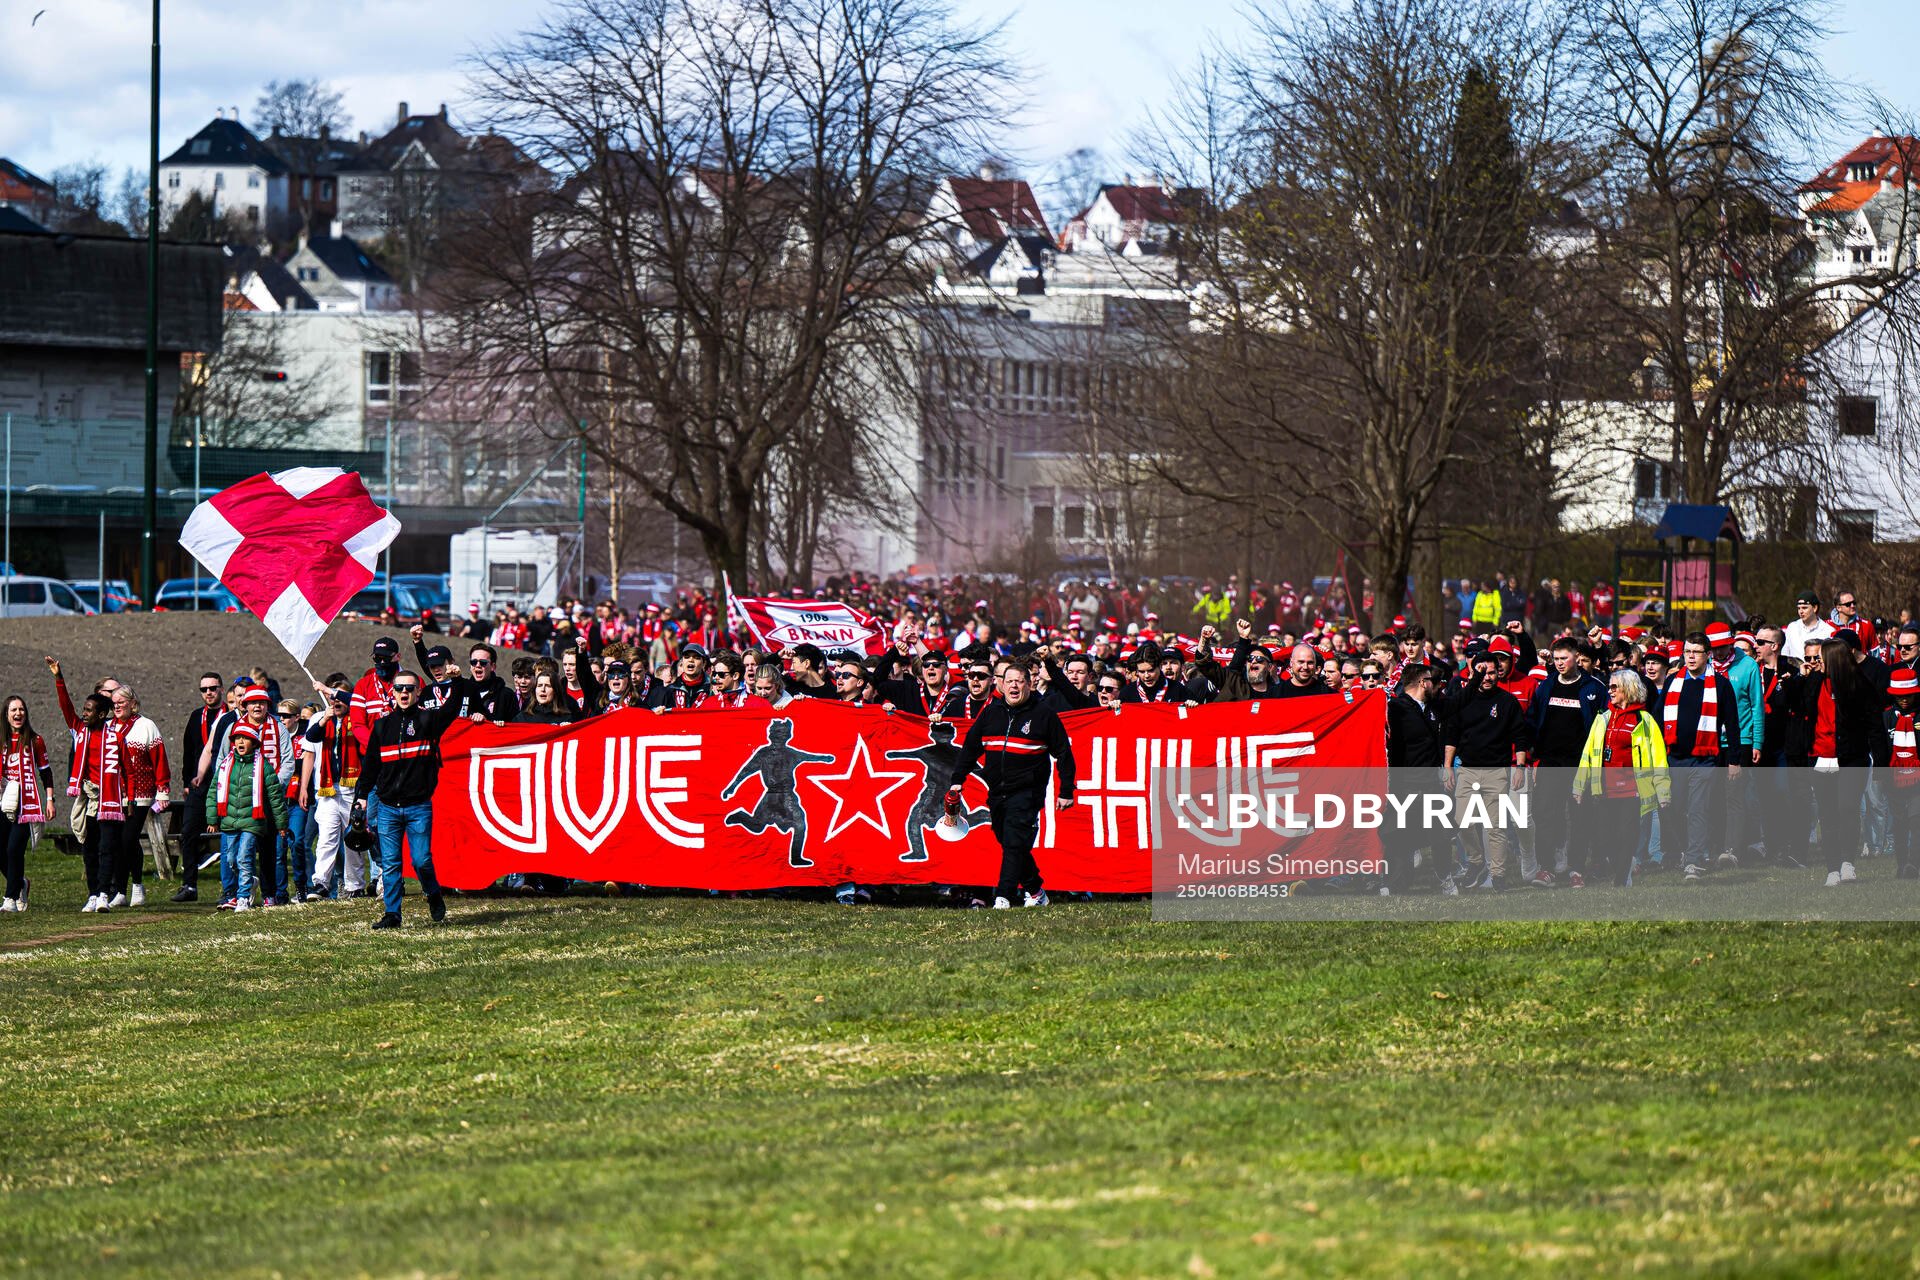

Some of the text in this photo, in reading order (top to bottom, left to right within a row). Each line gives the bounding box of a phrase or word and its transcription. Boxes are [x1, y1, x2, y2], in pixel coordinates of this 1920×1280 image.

[787, 628, 854, 641] BRANN
[23, 744, 35, 799] OLTHET
[104, 728, 119, 773] ANN
[469, 734, 705, 854] OVE
